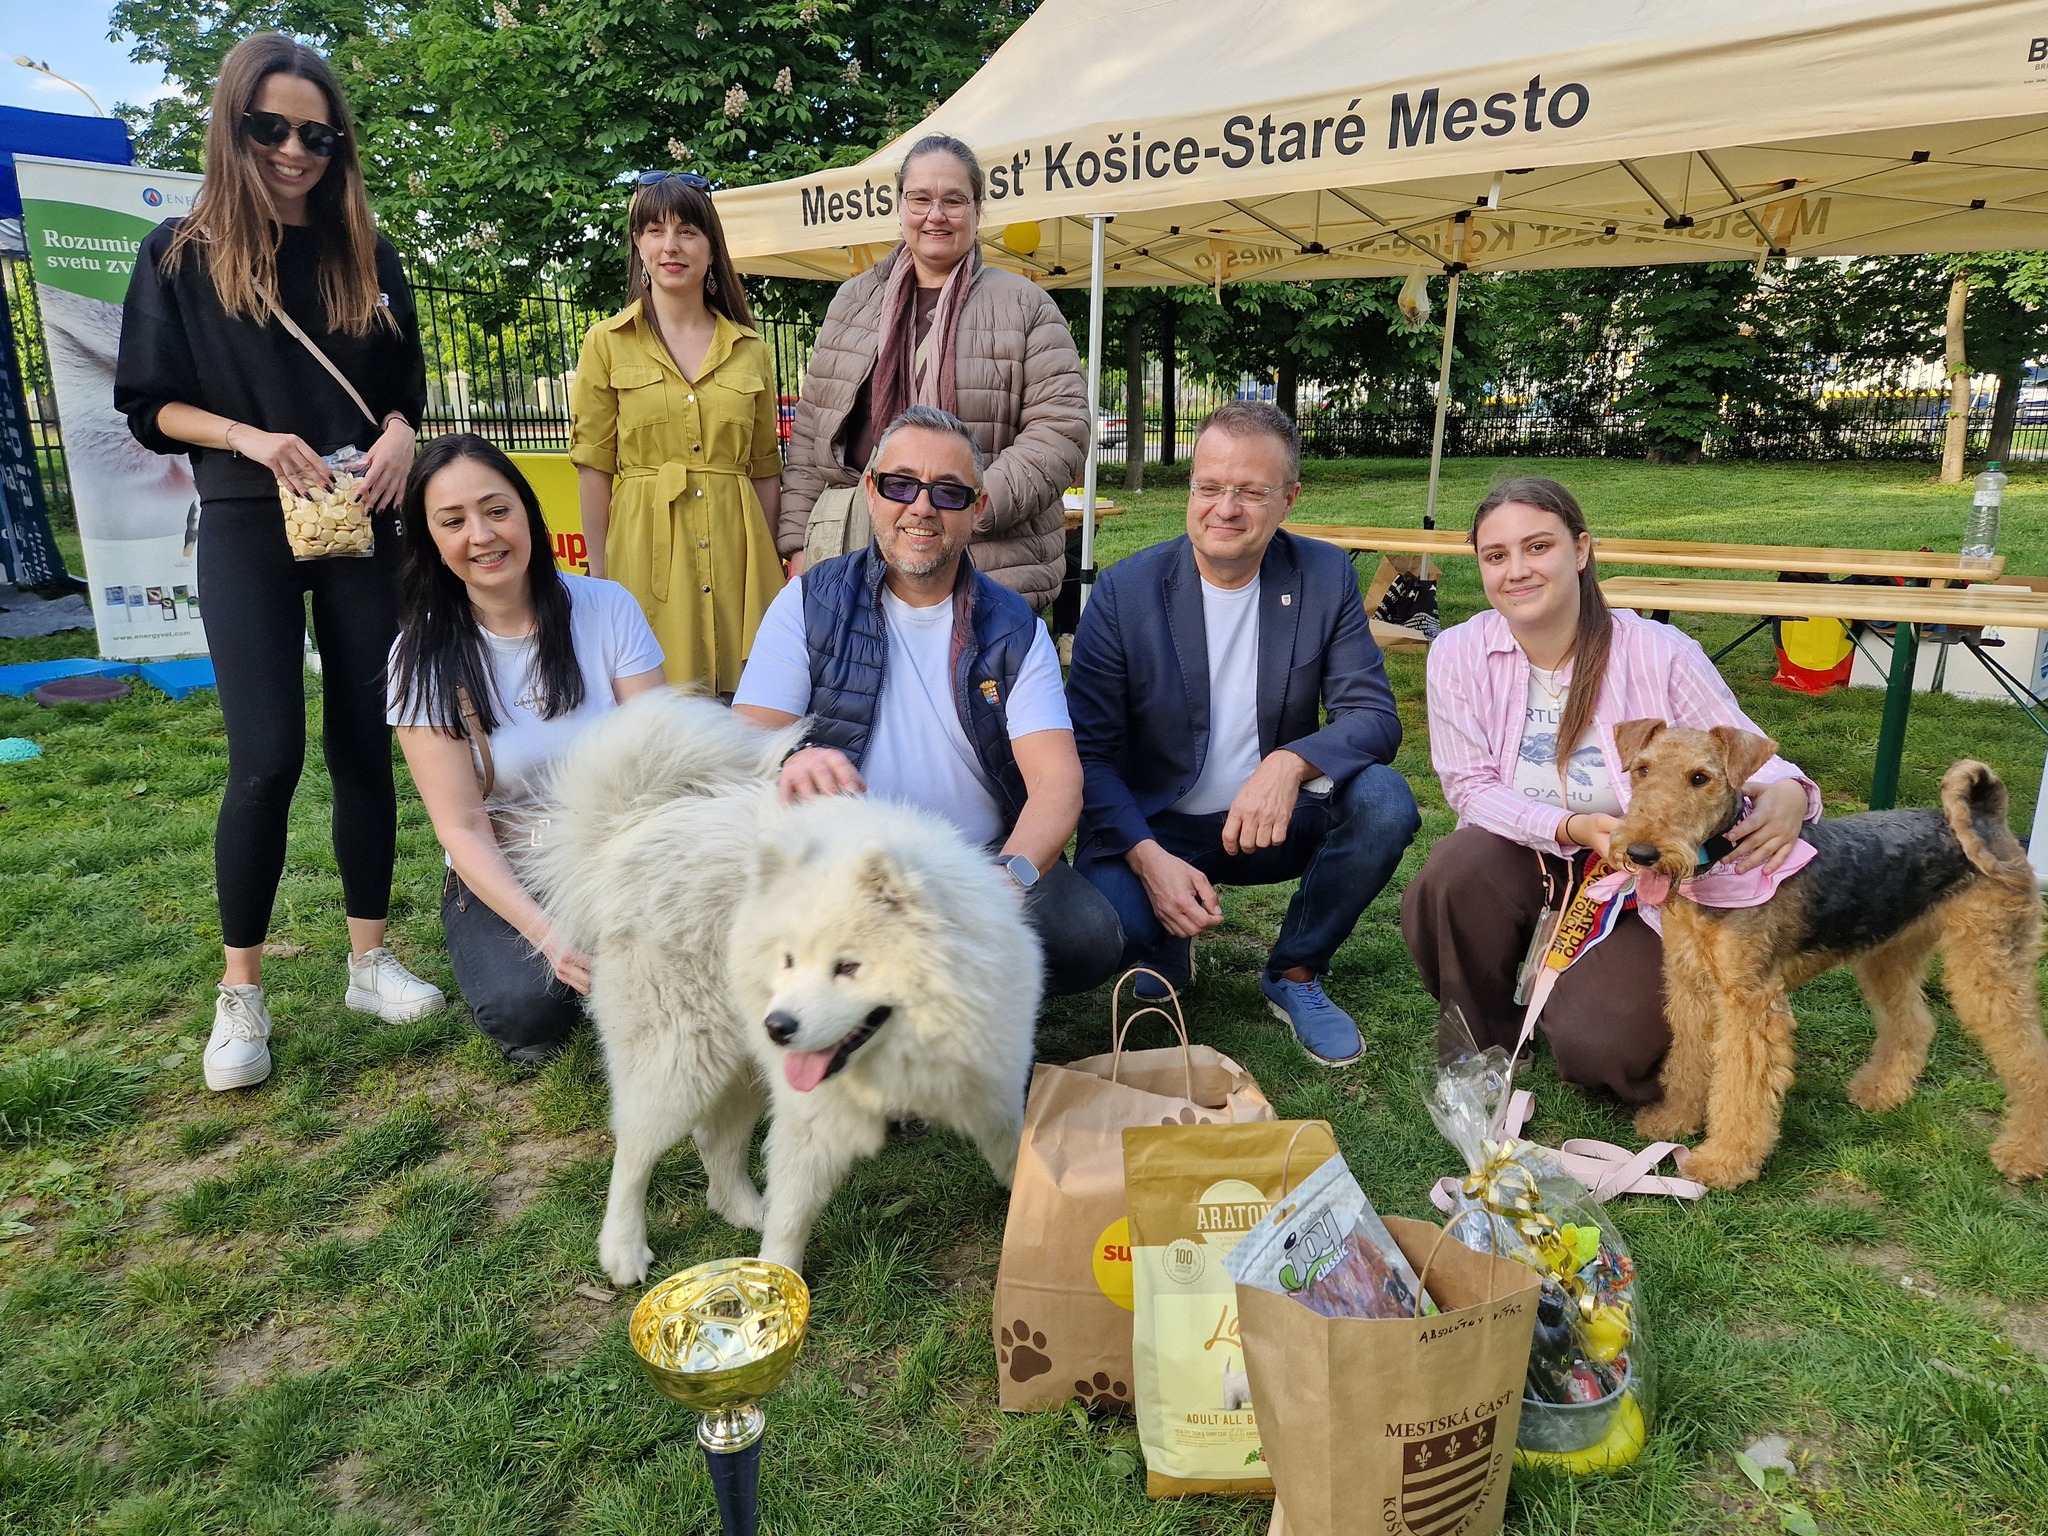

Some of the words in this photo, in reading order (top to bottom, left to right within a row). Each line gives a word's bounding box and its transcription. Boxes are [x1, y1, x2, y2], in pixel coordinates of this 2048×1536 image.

[801, 178, 899, 227] Mests
[984, 149, 1031, 200] sť
[1045, 98, 1367, 191] Košice-Staré
[1389, 74, 1590, 150] Mesto
[47, 255, 101, 271] svetu
[112, 629, 192, 641] www.energyvet.com
[1560, 895, 1591, 936] TOUCH
[1551, 936, 1568, 955] ME
[1563, 934, 1582, 959] DO
[1316, 1242, 1349, 1283] classic
[1384, 1406, 1470, 1438] MESTSKÁ
[1474, 1389, 1514, 1418] ČASŤ
[1473, 1453, 1503, 1514] MESTO
